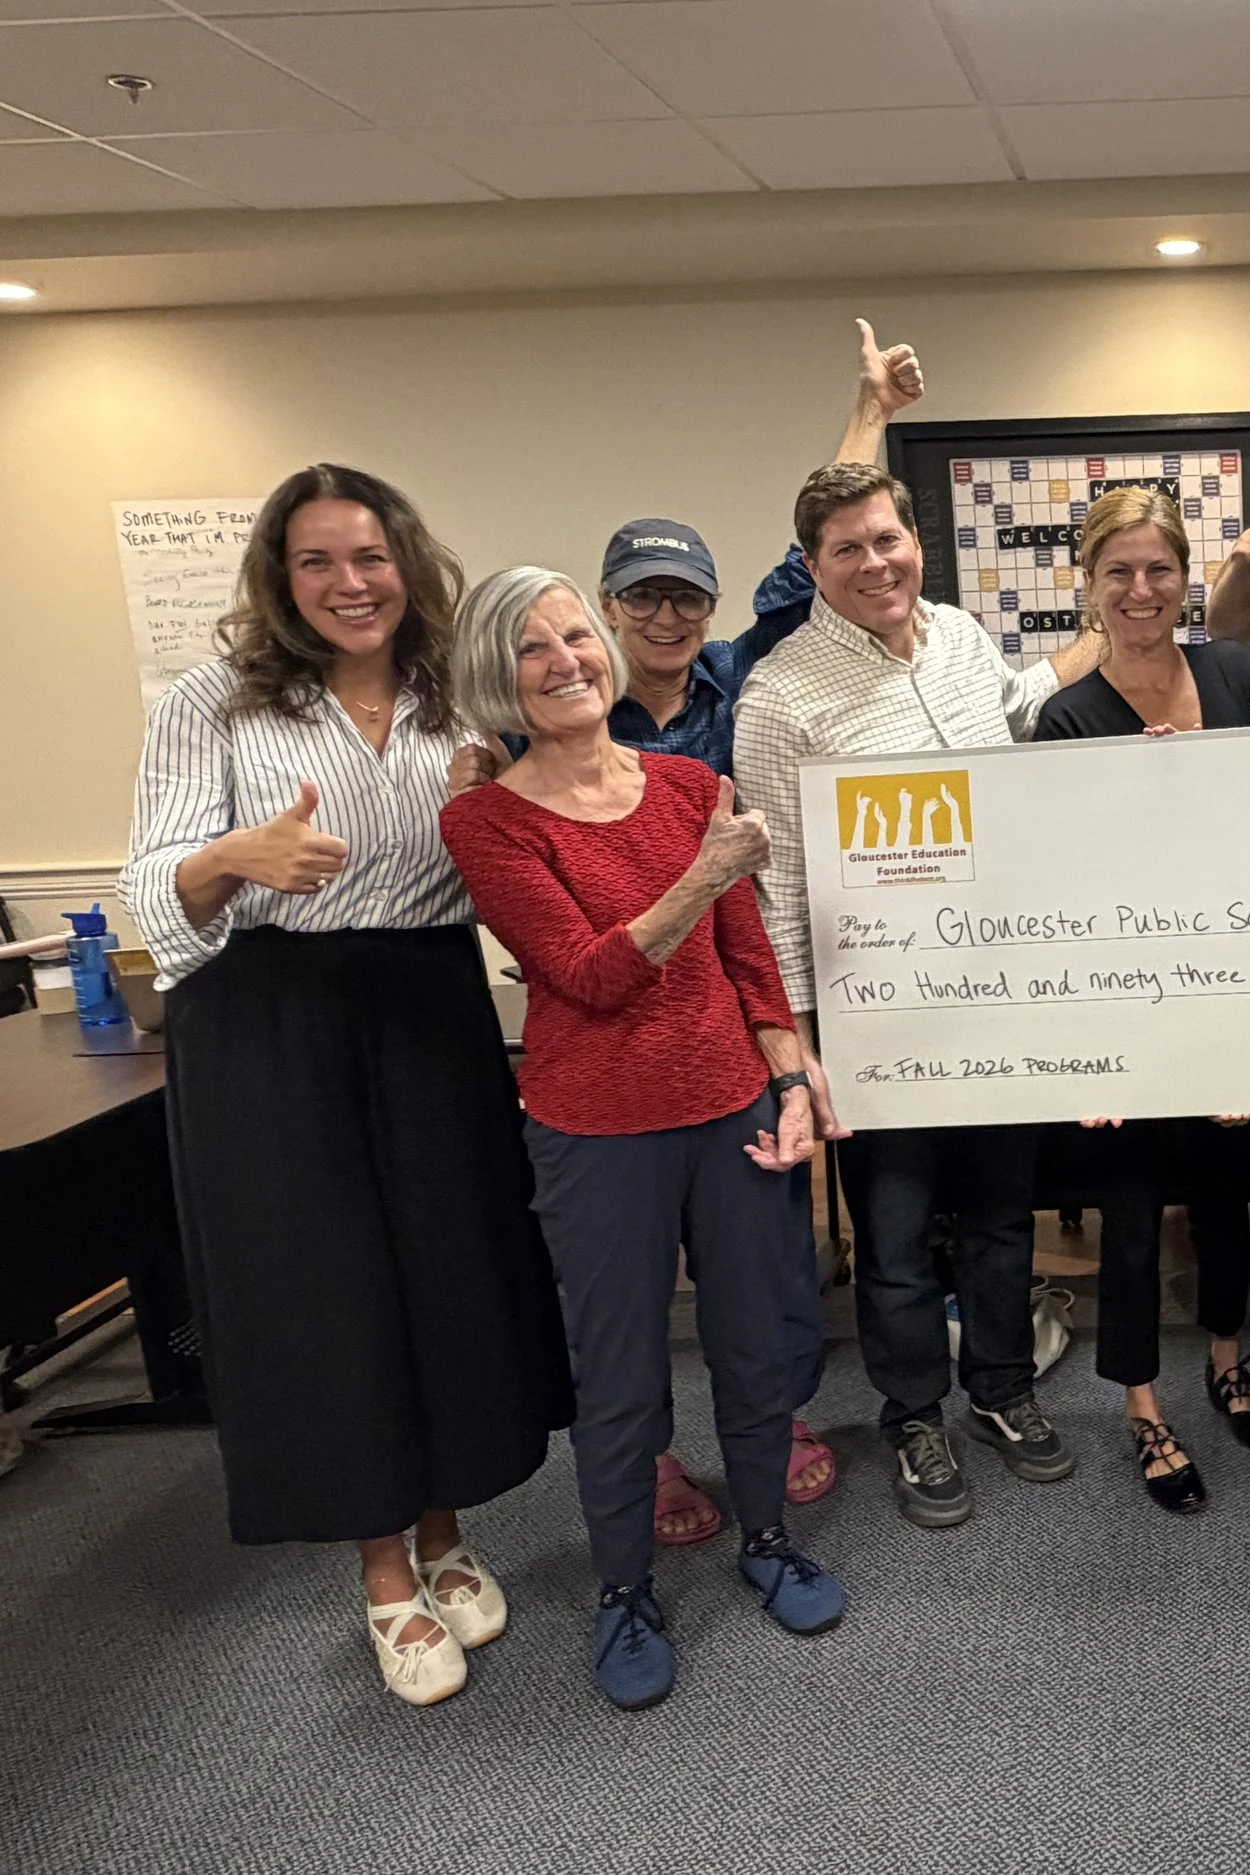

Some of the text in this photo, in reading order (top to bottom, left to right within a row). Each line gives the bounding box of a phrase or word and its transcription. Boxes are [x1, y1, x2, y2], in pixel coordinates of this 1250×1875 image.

[122, 510, 207, 529] SOMETHING
[120, 531, 161, 546] YEAR
[164, 532, 195, 545] THAT
[848, 847, 967, 863] Gloucester Education
[877, 863, 941, 876] Foundation
[838, 914, 888, 937] Pay to
[936, 907, 1098, 946] Gloucester
[1115, 905, 1211, 935] Public
[837, 938, 858, 950] the
[860, 937, 896, 950] order
[914, 970, 1013, 1001] Hundred
[1028, 969, 1080, 999] and
[1089, 968, 1164, 1004] ninety
[1170, 963, 1247, 987] three
[855, 1064, 896, 1083] For:
[894, 1055, 1126, 1079] FALL 2026 PROGRAMS
